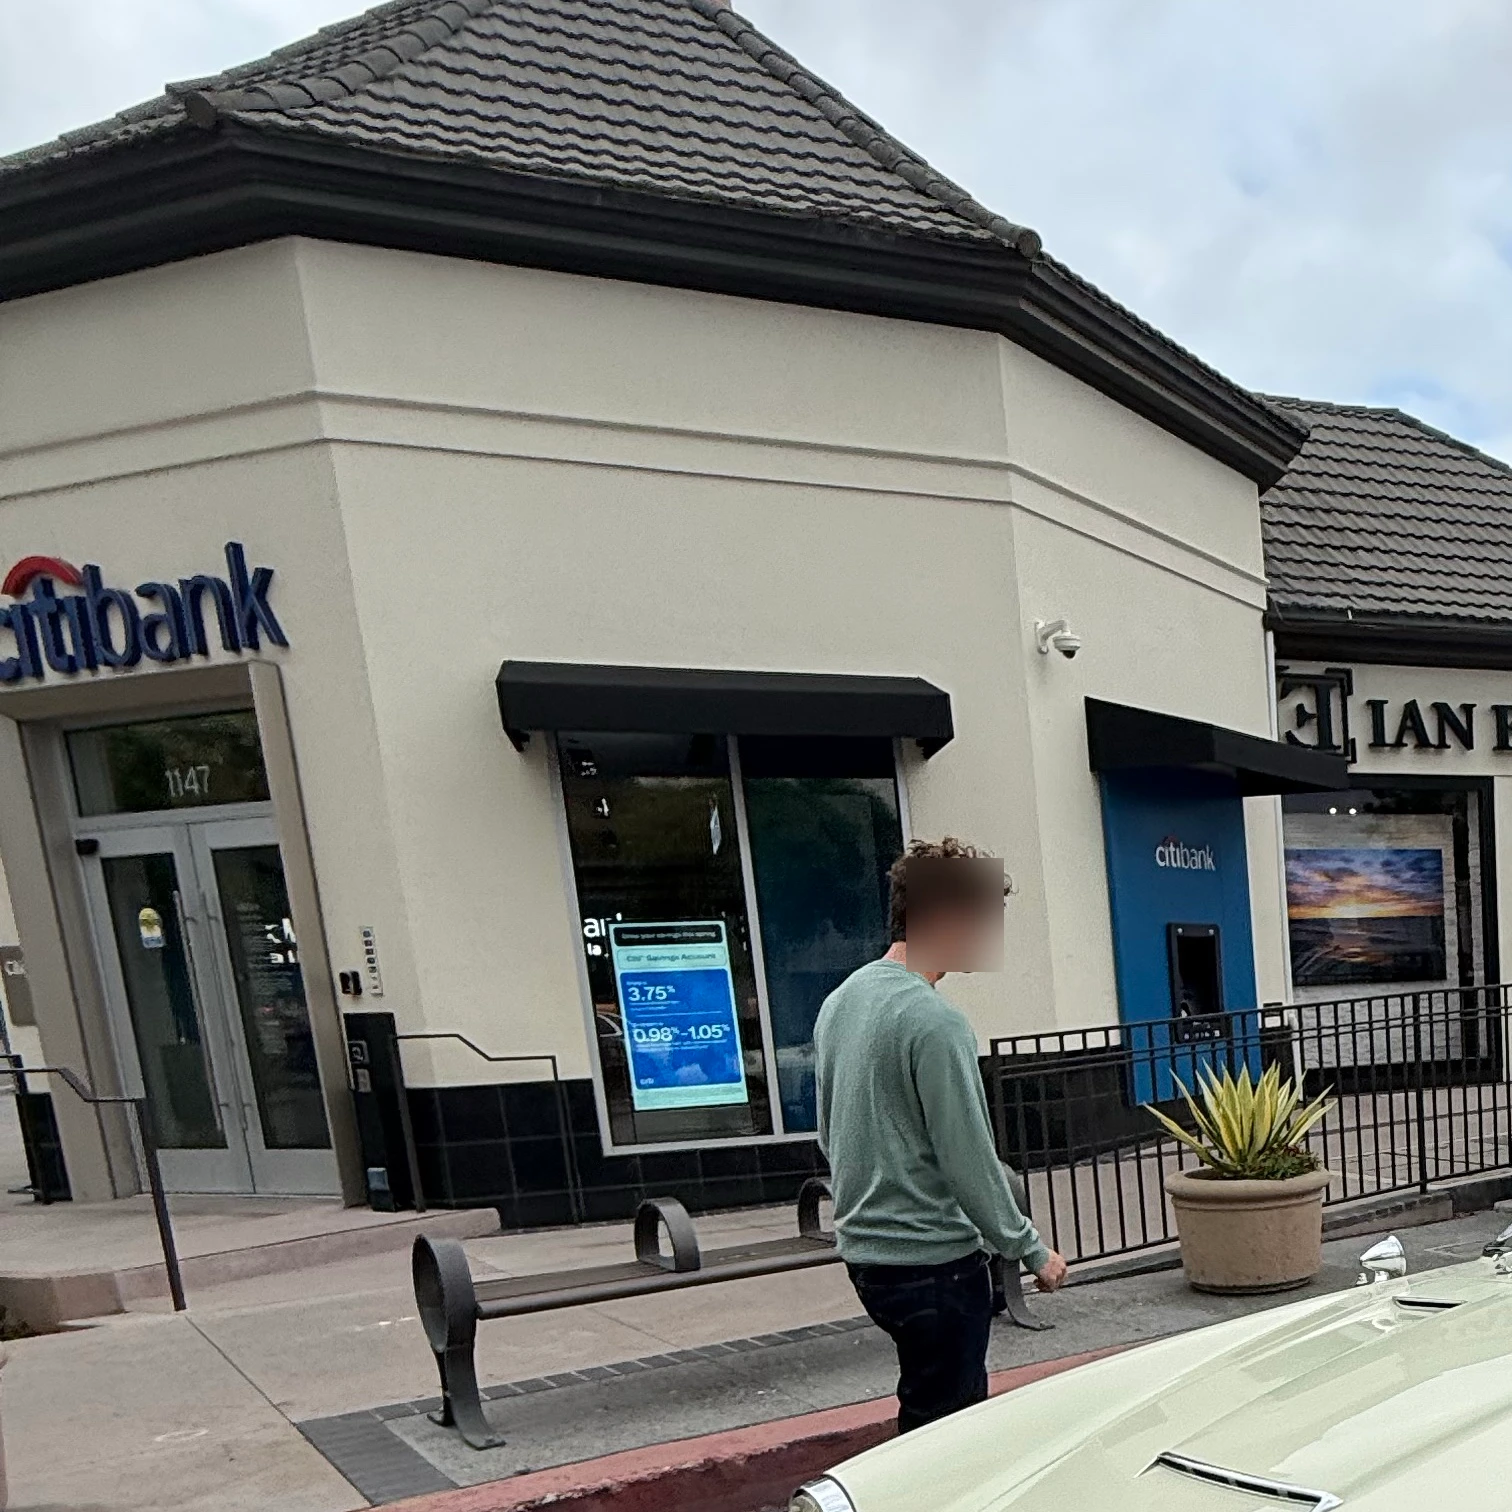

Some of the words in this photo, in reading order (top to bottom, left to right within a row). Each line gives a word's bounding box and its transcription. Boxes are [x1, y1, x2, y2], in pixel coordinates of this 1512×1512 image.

[1366, 699, 1477, 750] IAN
[165, 765, 210, 798] 1147
[1155, 841, 1217, 872] citibank
